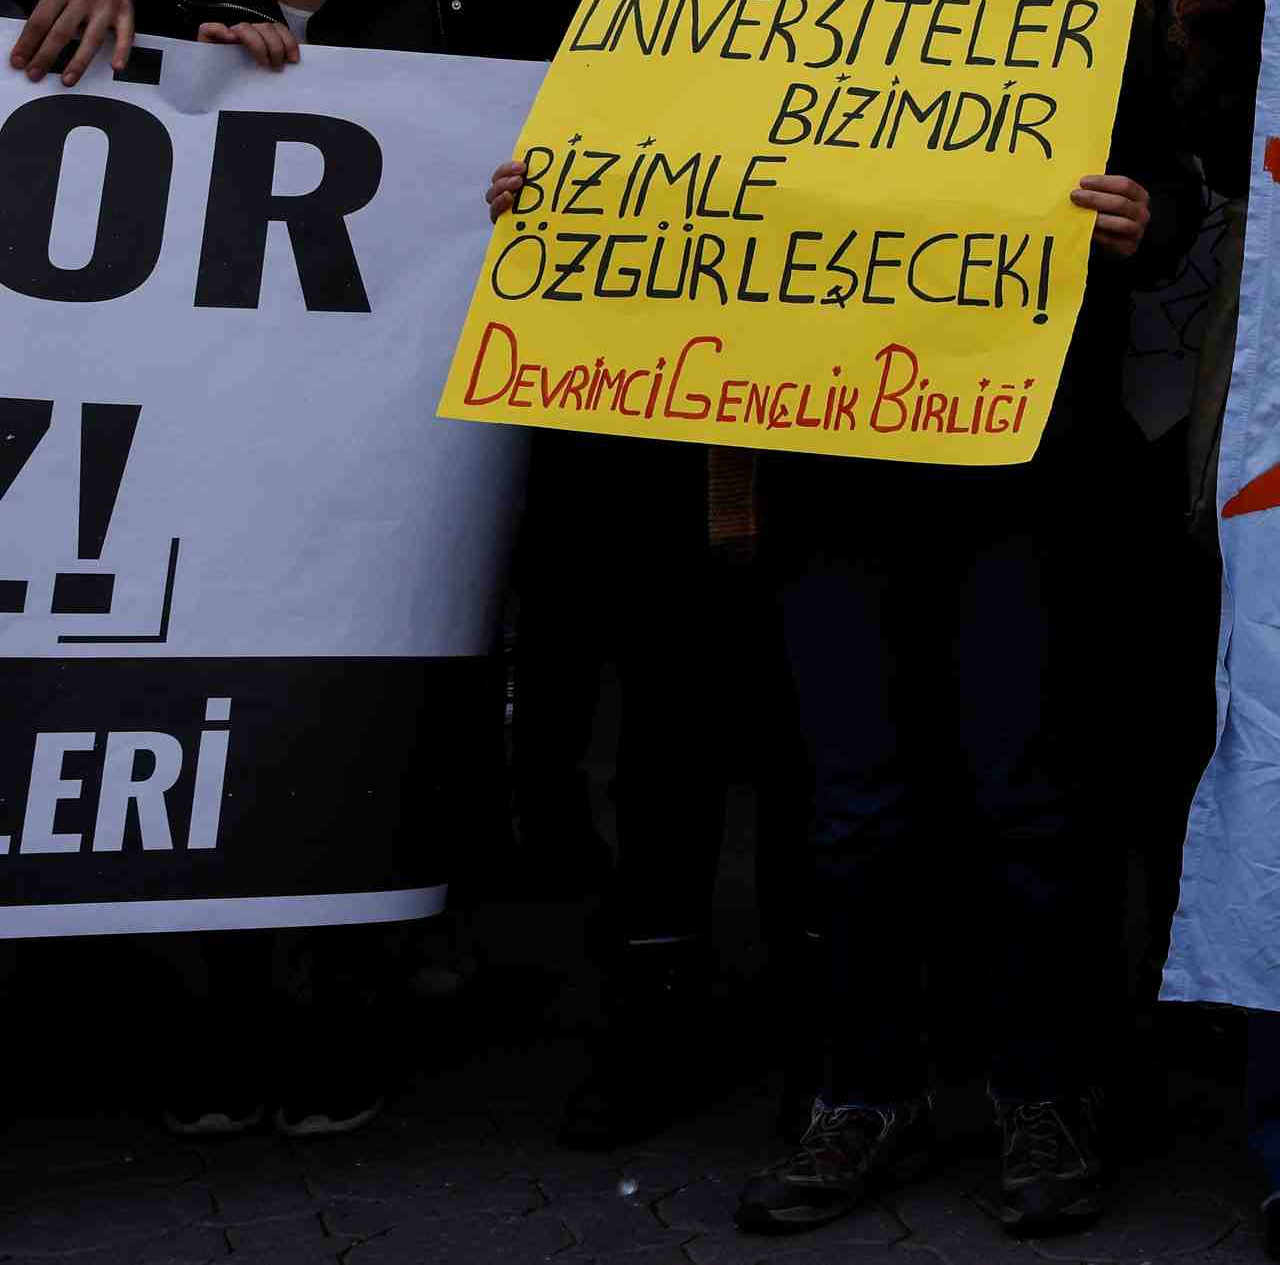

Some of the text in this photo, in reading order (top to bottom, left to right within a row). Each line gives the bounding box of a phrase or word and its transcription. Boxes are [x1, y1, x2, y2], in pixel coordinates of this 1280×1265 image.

[768, 73, 1058, 160] BİZİMDİR
[511, 133, 787, 221] BİZİMLE
[491, 221, 1054, 326] ÖZGÜRLEŞECEK!
[0, 698, 233, 856] ERİ
